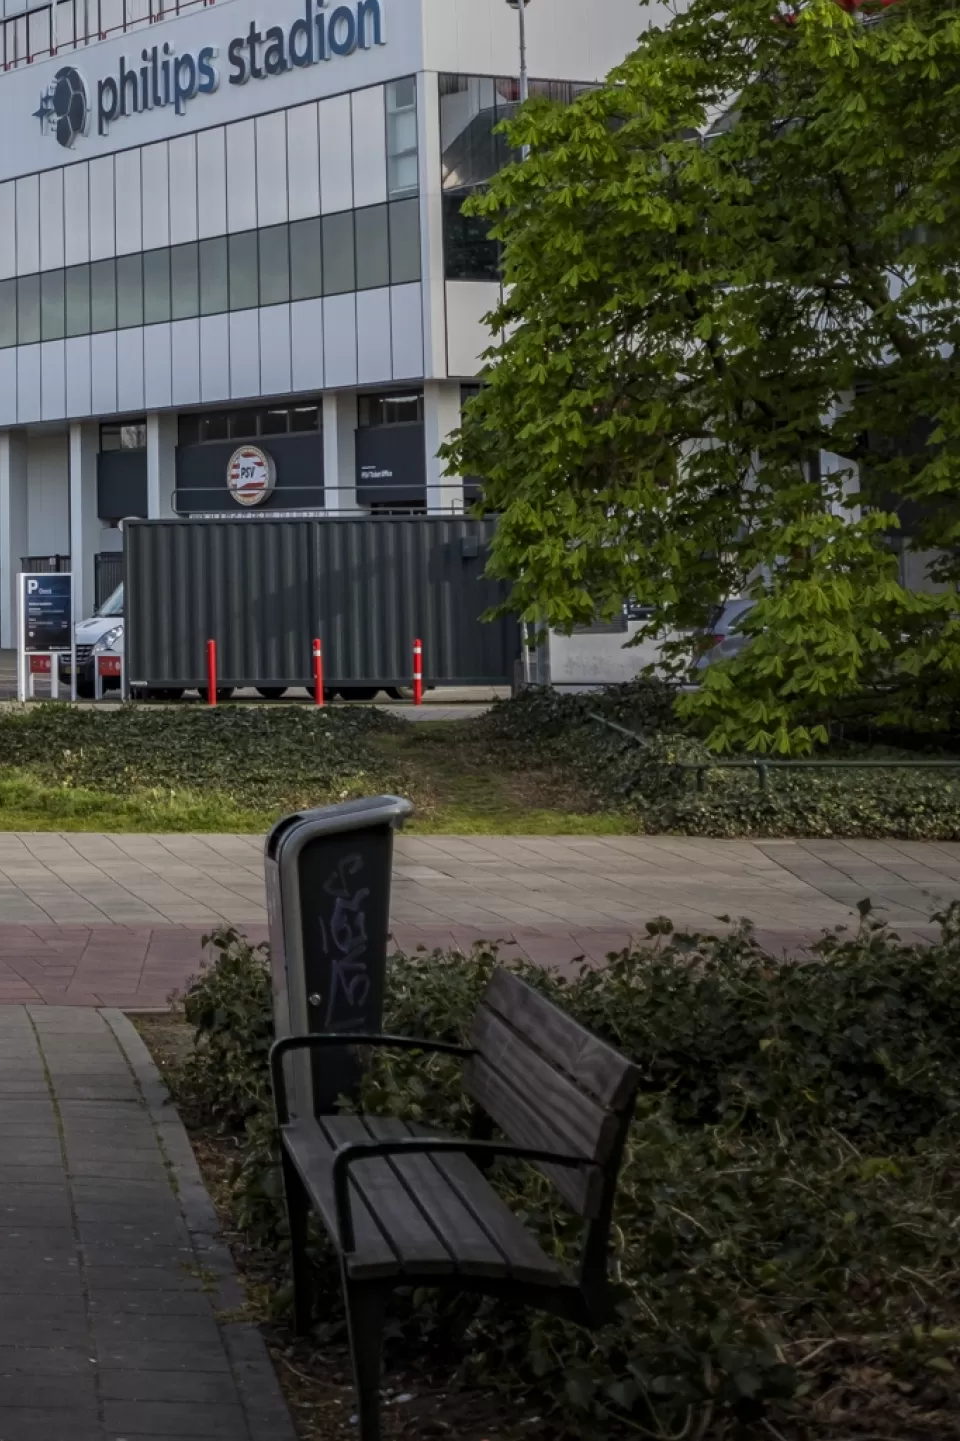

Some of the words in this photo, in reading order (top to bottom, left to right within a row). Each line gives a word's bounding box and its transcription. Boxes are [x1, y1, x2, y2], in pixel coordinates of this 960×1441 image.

[97, 42, 219, 136] philips
[240, 466, 255, 479] PSV
[27, 580, 38, 594] P
